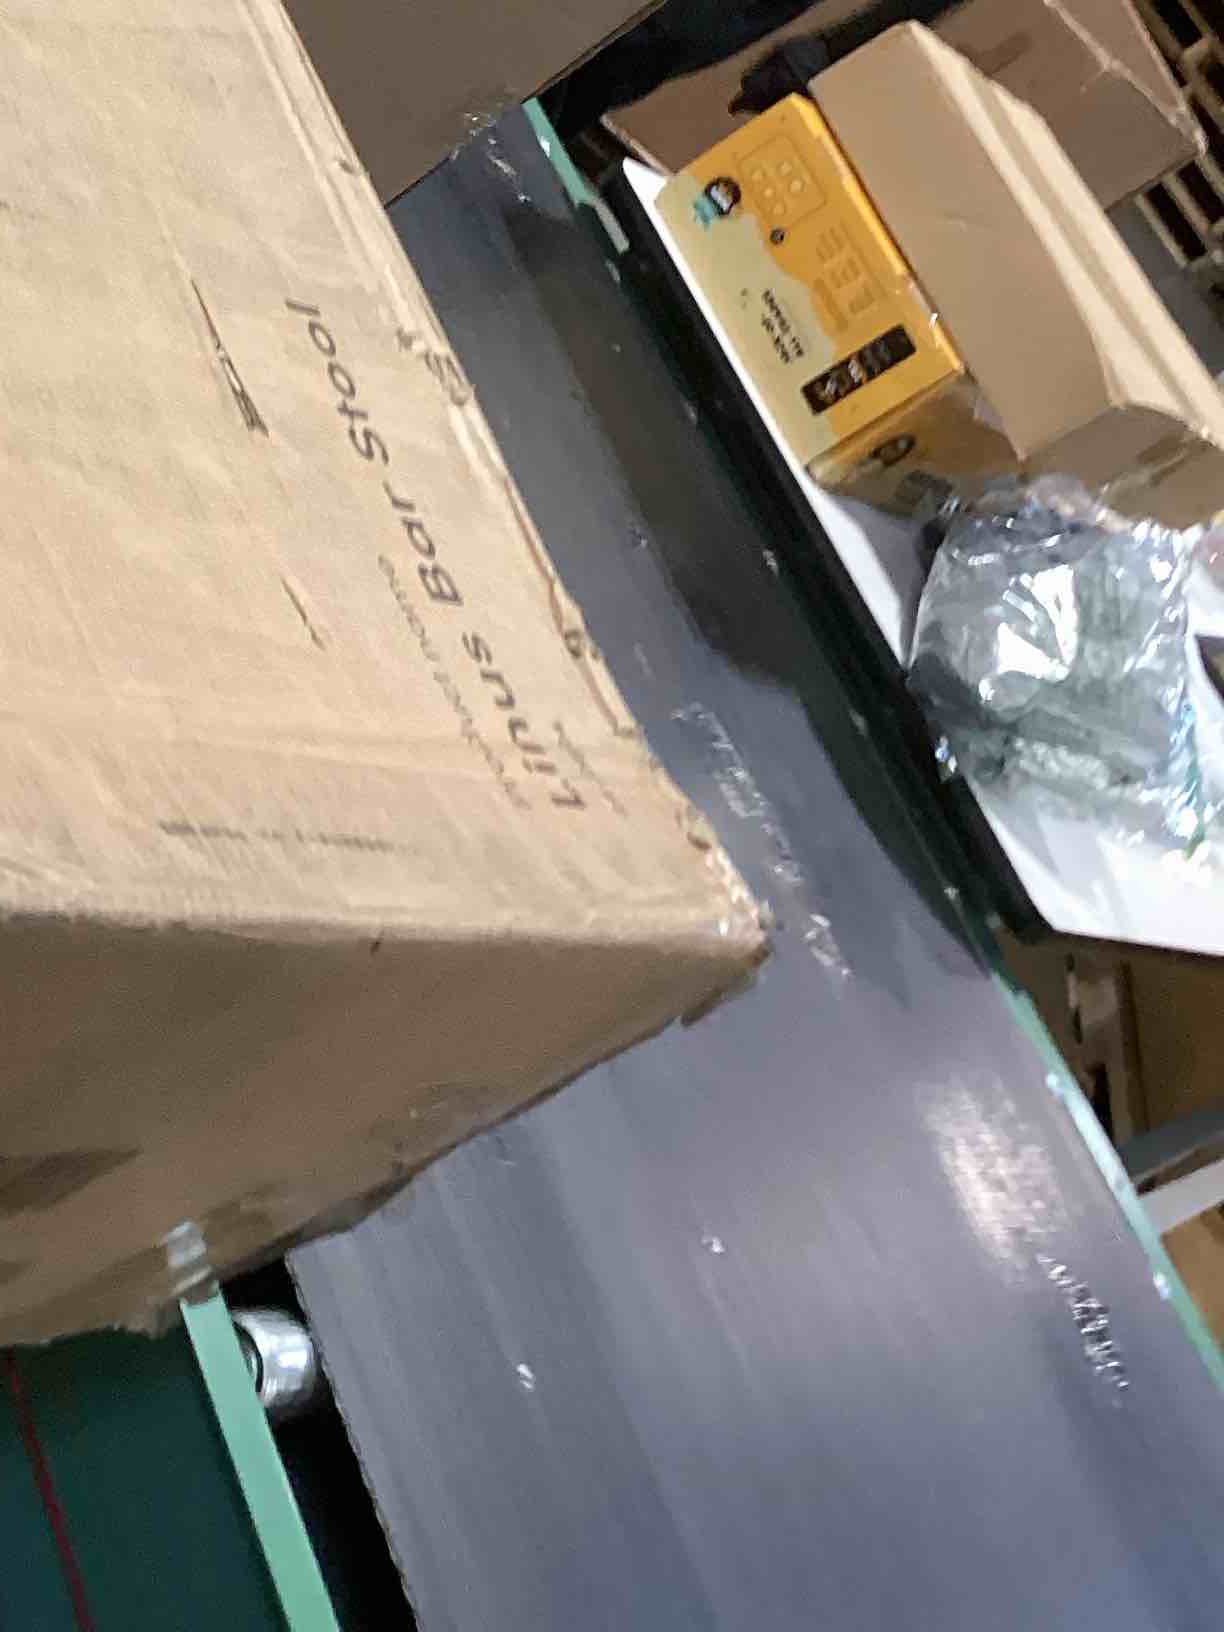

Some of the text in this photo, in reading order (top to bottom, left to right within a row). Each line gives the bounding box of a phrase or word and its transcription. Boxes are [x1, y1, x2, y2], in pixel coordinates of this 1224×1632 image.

[284, 298, 585, 812] Linus Bar Stool
